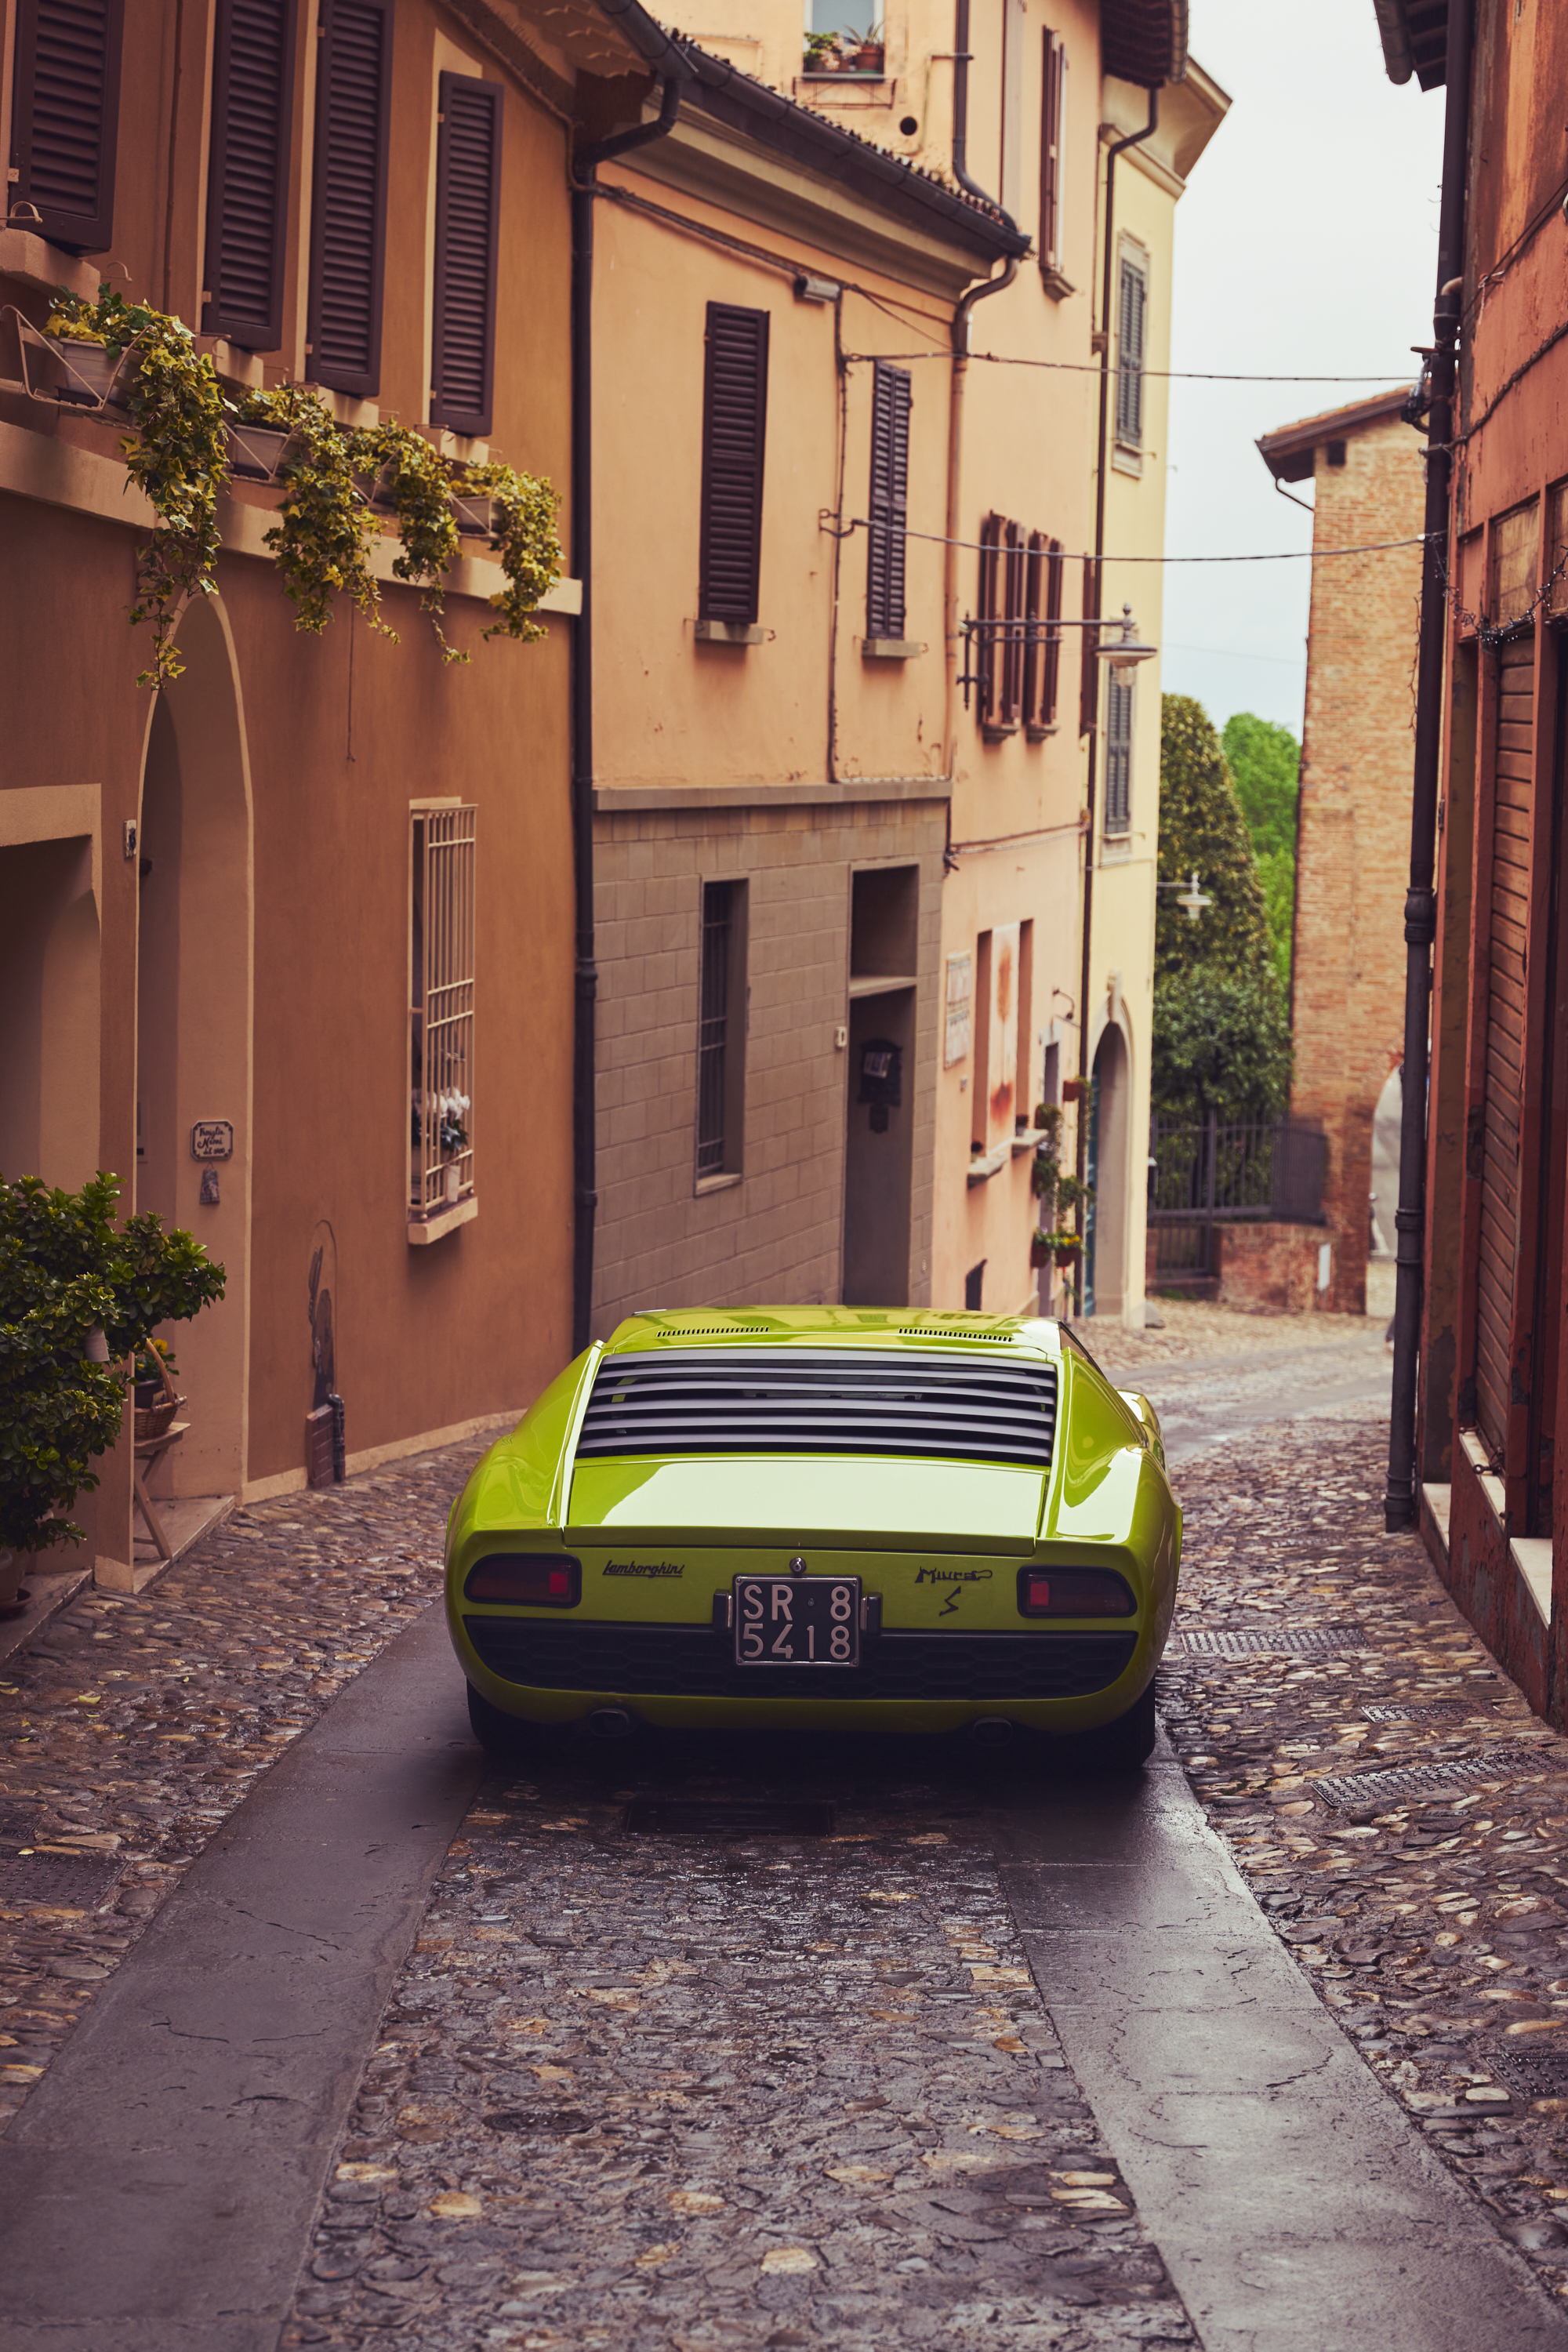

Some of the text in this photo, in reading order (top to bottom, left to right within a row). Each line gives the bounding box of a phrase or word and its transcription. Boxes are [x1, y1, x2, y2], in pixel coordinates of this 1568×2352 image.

[602, 1559, 685, 1578] Lamborghini
[914, 1566, 993, 1584] Miura
[743, 1584, 851, 1621] SR 8
[938, 1585, 962, 1617] S
[742, 1623, 851, 1661] 5418
